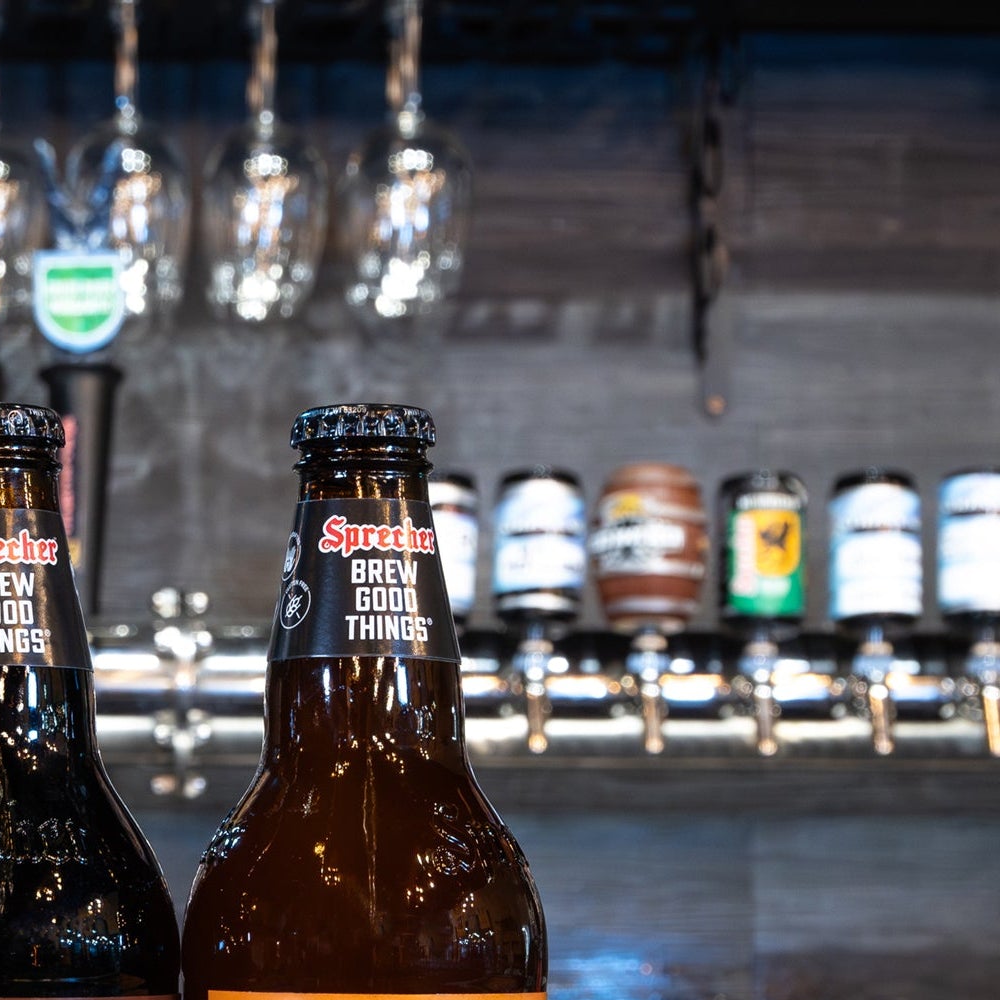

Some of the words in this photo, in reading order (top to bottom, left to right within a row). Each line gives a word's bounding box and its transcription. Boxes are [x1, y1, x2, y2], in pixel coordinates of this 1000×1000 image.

[318, 514, 435, 559] Sprecher
[351, 559, 418, 585] BREW
[355, 586, 418, 613] GOOD
